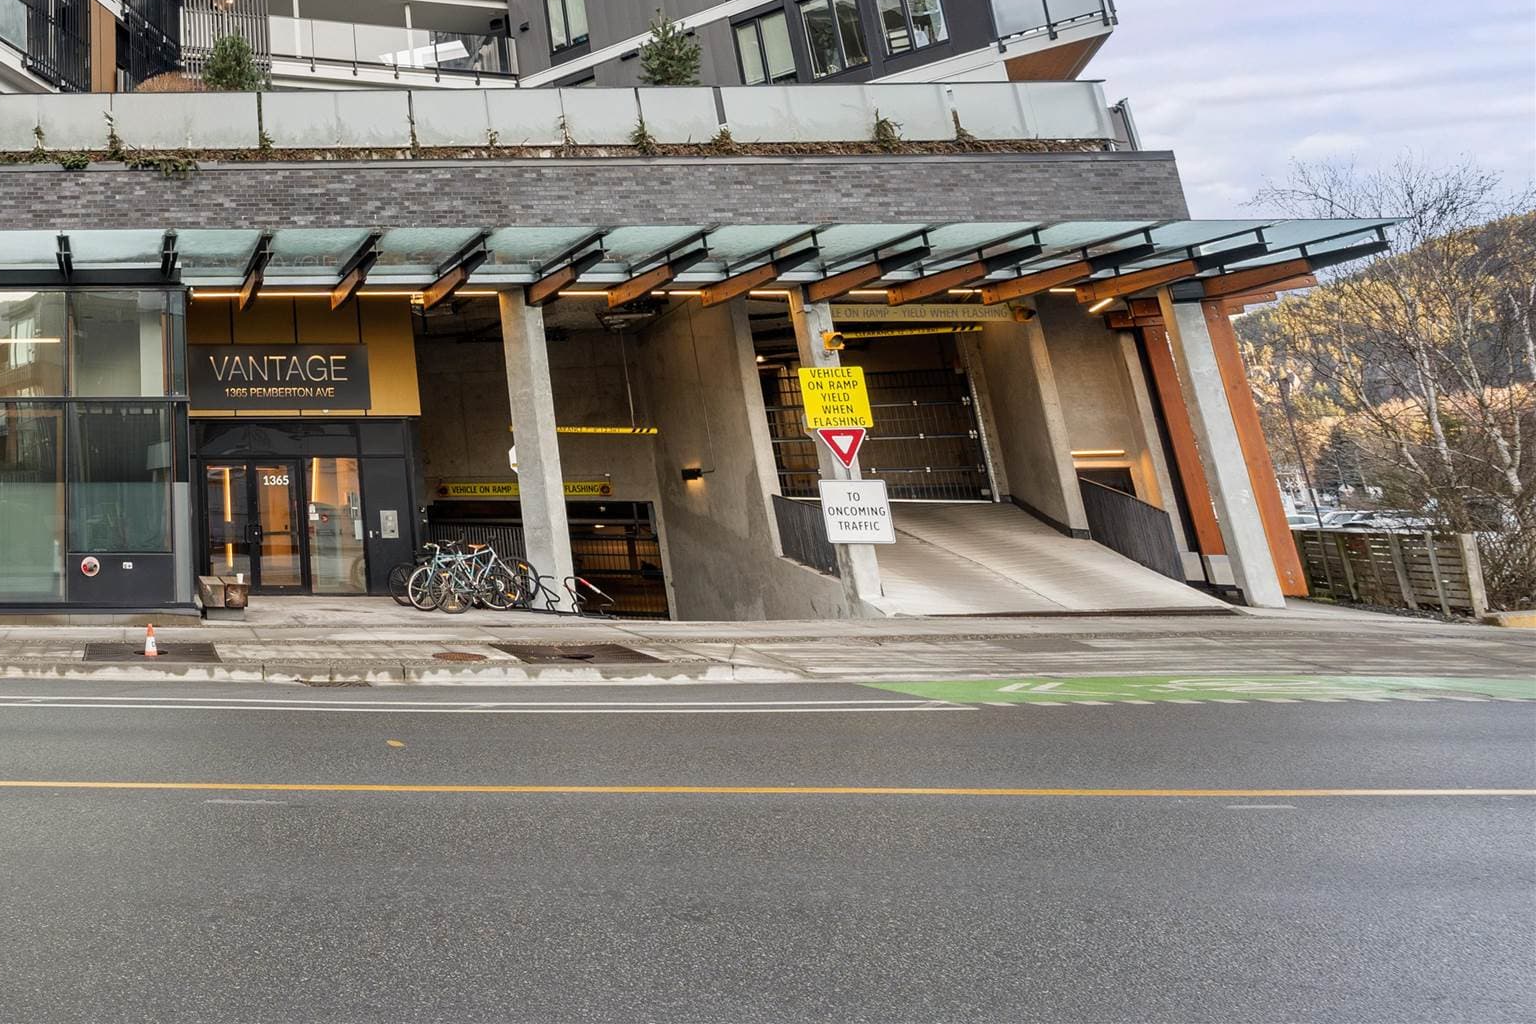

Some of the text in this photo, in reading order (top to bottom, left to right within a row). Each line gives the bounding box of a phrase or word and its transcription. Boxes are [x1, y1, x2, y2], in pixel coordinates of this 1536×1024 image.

[844, 308, 859, 318] ON
[863, 308, 889, 318] RAMP
[902, 308, 926, 318] YIELD
[930, 308, 959, 318] WHEN
[962, 308, 1008, 318] FLASHING
[209, 355, 348, 382] VANTAGE
[810, 368, 853, 378] VEHICLE
[807, 380, 858, 391] ON RAMP
[225, 387, 335, 398] 1365 PEMBERTON AVE
[821, 392, 850, 402] YIELD
[822, 405, 854, 414] WHEN
[813, 417, 866, 427] FLASHING
[263, 475, 290, 486] 1365
[451, 485, 477, 494] VEHICLE
[479, 485, 490, 494] ON
[492, 485, 512, 494] RAMP
[565, 484, 600, 494] FLASHING
[847, 492, 861, 502] TO
[827, 506, 886, 516] ONCOMING
[838, 521, 881, 531] TRAFFIC
